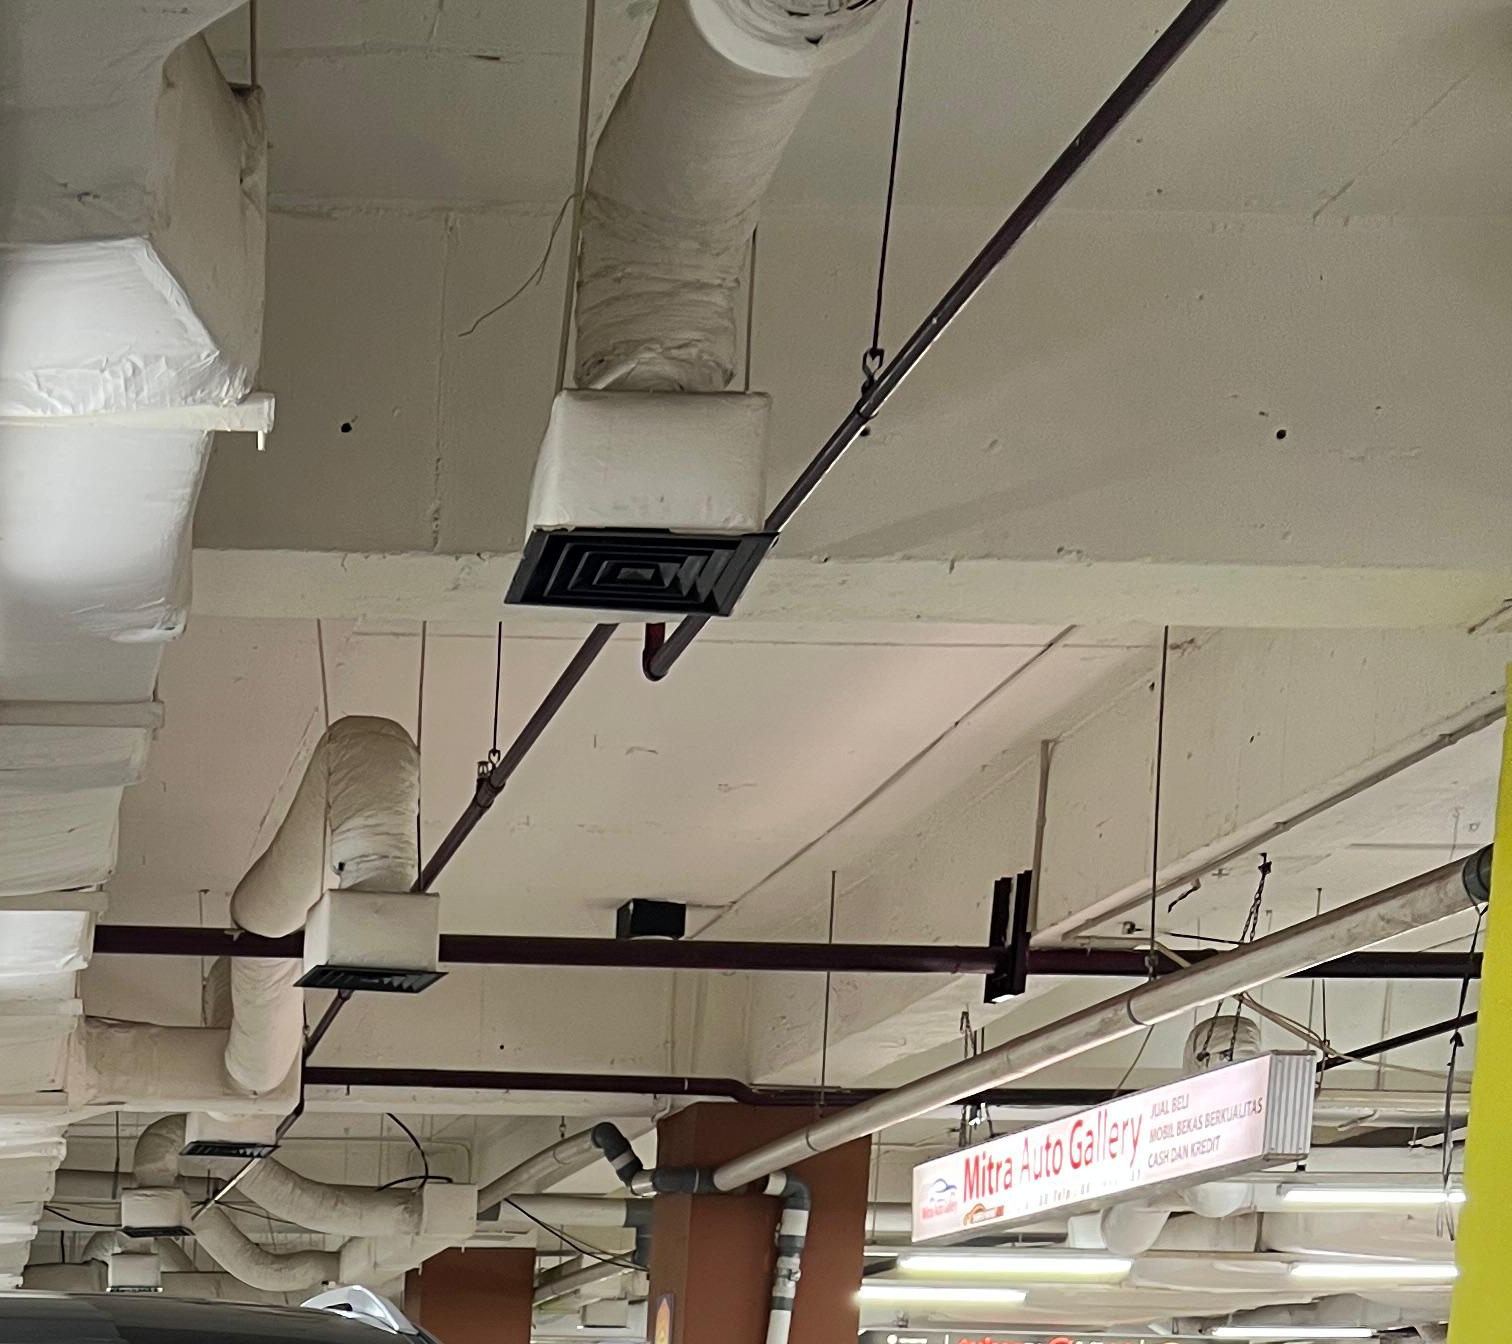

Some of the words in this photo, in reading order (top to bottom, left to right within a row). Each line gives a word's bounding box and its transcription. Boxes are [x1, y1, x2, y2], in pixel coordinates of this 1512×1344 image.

[1149, 1123, 1175, 1143] MOBIL
[1177, 1114, 1203, 1137] BEKAS
[1205, 1097, 1263, 1129] BERKUALITAS
[1151, 1099, 1170, 1120] JUAL
[1172, 1094, 1190, 1113] BELI
[963, 1151, 1013, 1203] Mitra
[1020, 1136, 1063, 1182] Auto
[1069, 1109, 1143, 1169] Gallery
[1147, 1149, 1169, 1168] CASH
[1171, 1143, 1189, 1163] DAN
[1191, 1135, 1221, 1157] KREDIT
